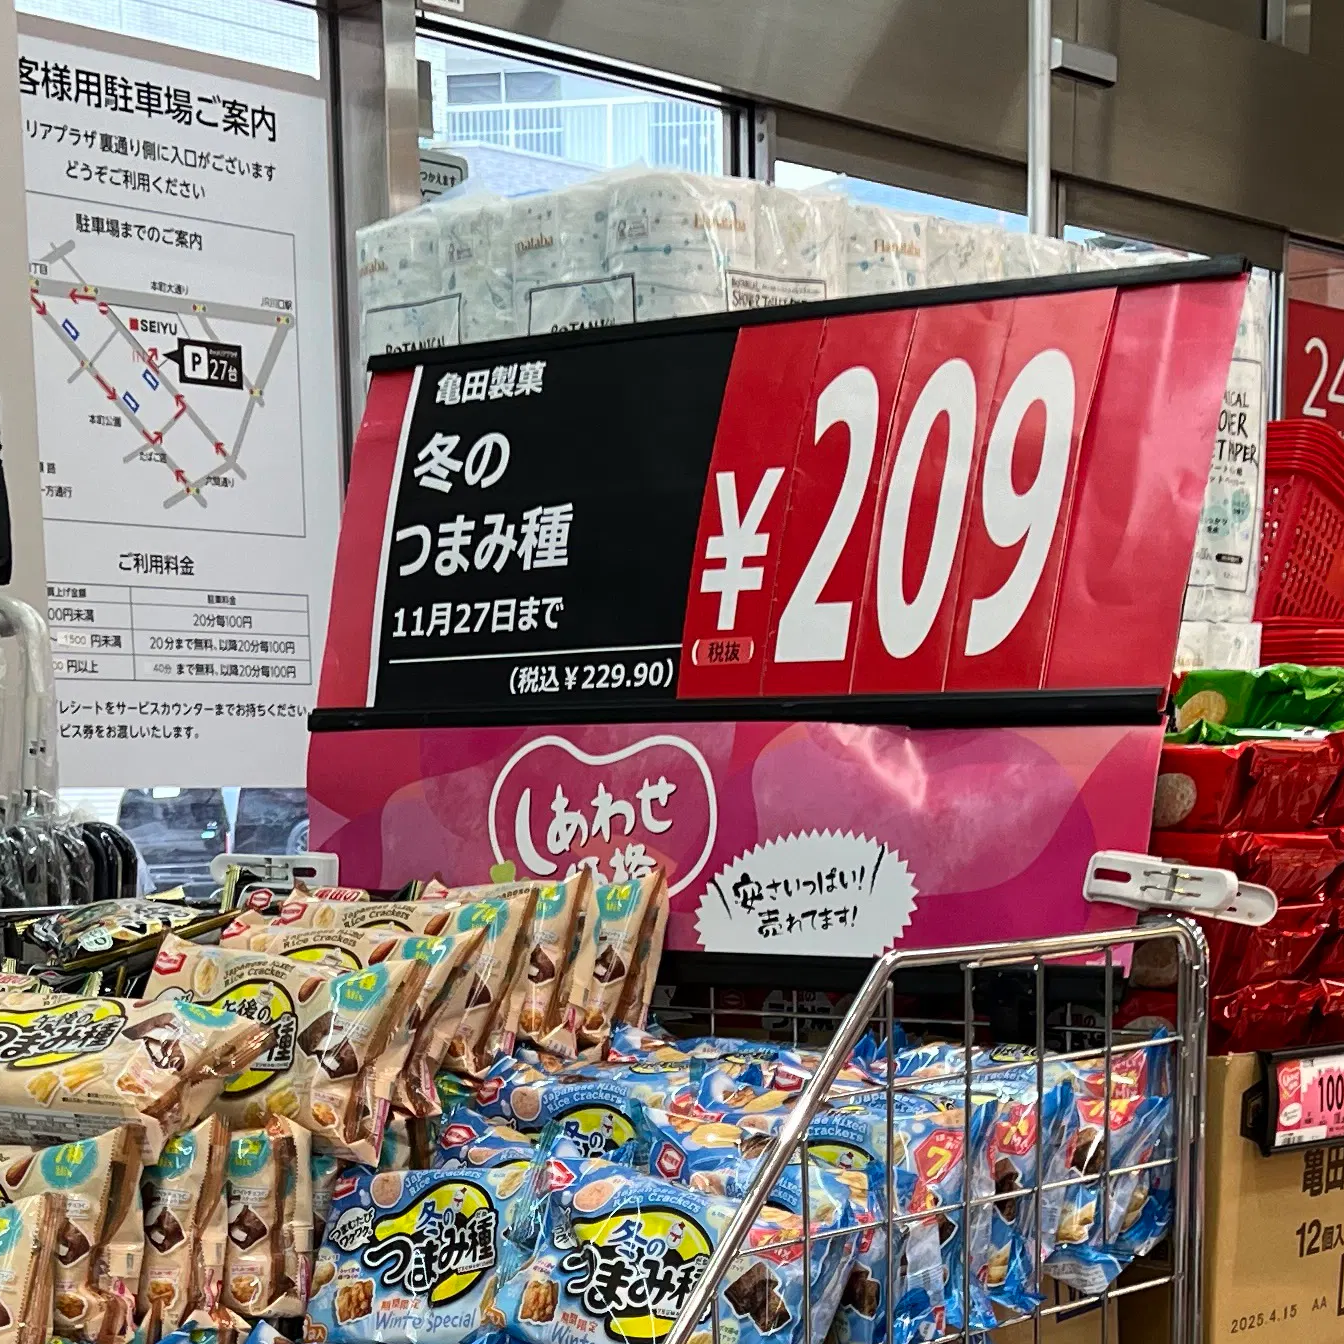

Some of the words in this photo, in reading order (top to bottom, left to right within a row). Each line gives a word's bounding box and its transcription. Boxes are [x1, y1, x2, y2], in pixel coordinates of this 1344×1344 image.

[65, 160, 205, 199] どうぞご利用ください
[75, 213, 203, 251] 駐車場までのご案内
[140, 320, 178, 336] SEIYU
[209, 360, 237, 383] 27台
[436, 361, 546, 406] 亀田製菓
[414, 431, 510, 493] 冬の
[395, 503, 574, 577] つまみ種
[118, 553, 195, 576] ご利用料金
[392, 596, 564, 638] 11月27日まで
[516, 777, 676, 875] しあわせ
[731, 864, 869, 914] 安さいっぱい!
[756, 904, 859, 940] 売れてます!
[1317, 1074, 1344, 1113] 100
[363, 1214, 496, 1292] つまみ種
[611, 1219, 666, 1260] 冬の
[1296, 1218, 1344, 1258] 12個入
[426, 1308, 477, 1331] Special
